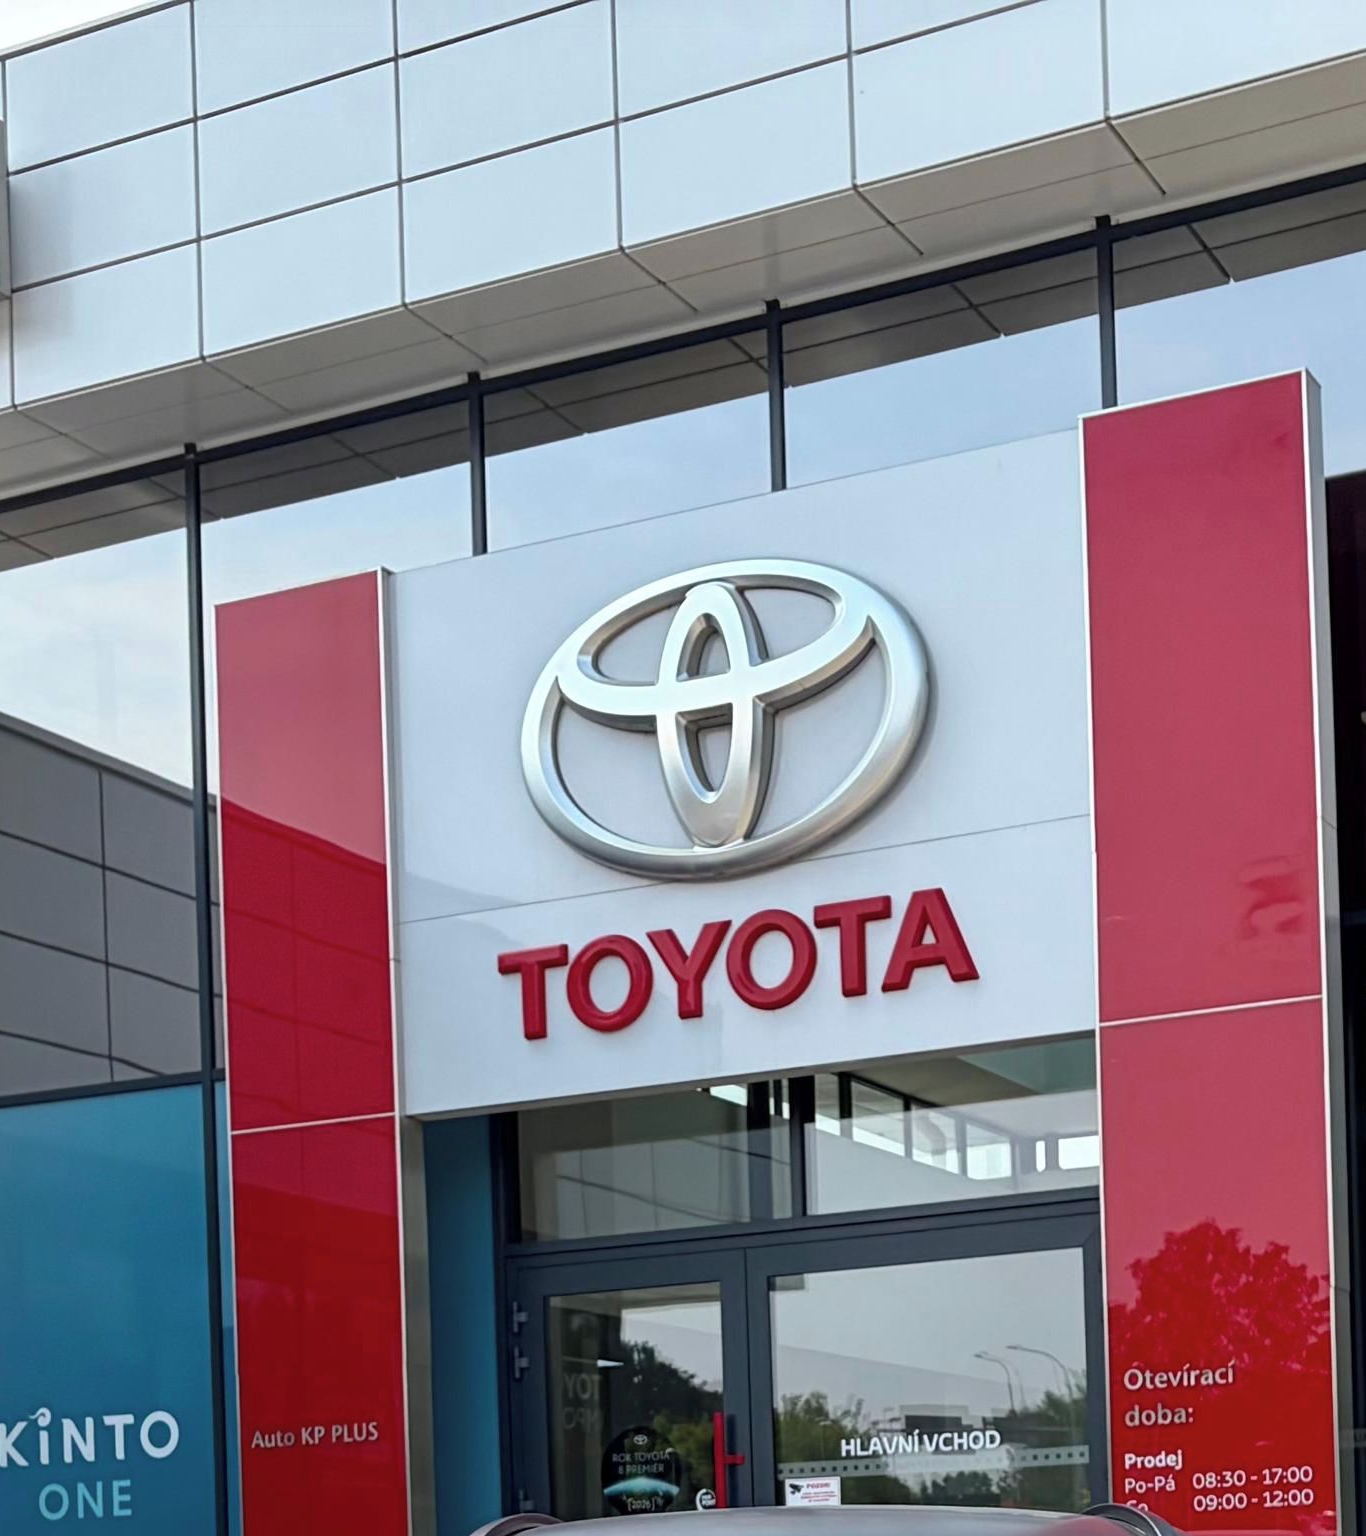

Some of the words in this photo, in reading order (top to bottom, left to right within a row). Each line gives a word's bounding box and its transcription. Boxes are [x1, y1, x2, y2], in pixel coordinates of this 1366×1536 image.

[497, 887, 980, 1041] TOYOTA
[1124, 1360, 1235, 1390] Otevírací
[1125, 1403, 1194, 1427] doba:
[251, 1430, 295, 1448] Auto
[301, 1426, 325, 1445] KP
[331, 1422, 378, 1443] PLUS
[841, 1429, 920, 1457] HLAVNÍ
[923, 1430, 1001, 1452] VCHOD
[1125, 1450, 1182, 1471] Prodej
[1125, 1474, 1176, 1494] Po-Pá
[1193, 1470, 1246, 1489] 08:30
[1262, 1466, 1313, 1485] 17:00
[38, 1479, 133, 1521] ONE
[1193, 1492, 1247, 1512] 09:00
[1263, 1489, 1314, 1508] 12:00
